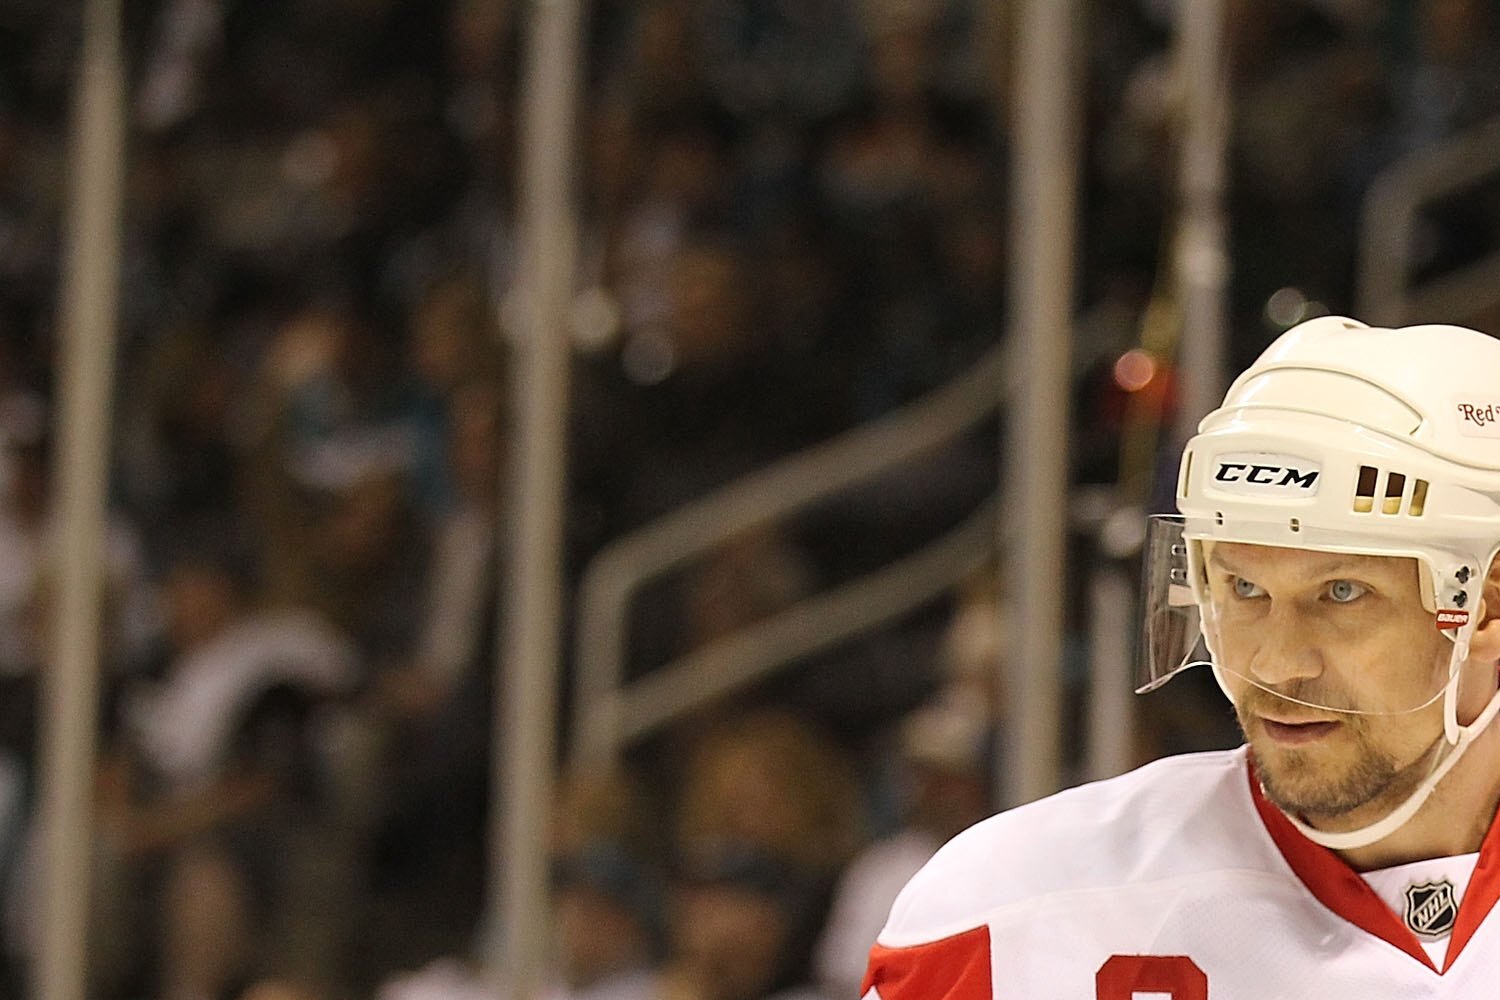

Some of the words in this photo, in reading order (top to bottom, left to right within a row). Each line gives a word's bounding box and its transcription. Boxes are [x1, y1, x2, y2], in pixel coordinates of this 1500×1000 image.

[1458, 404, 1495, 427] Red
[1215, 463, 1319, 488] CCM
[1417, 891, 1450, 928] NHL
